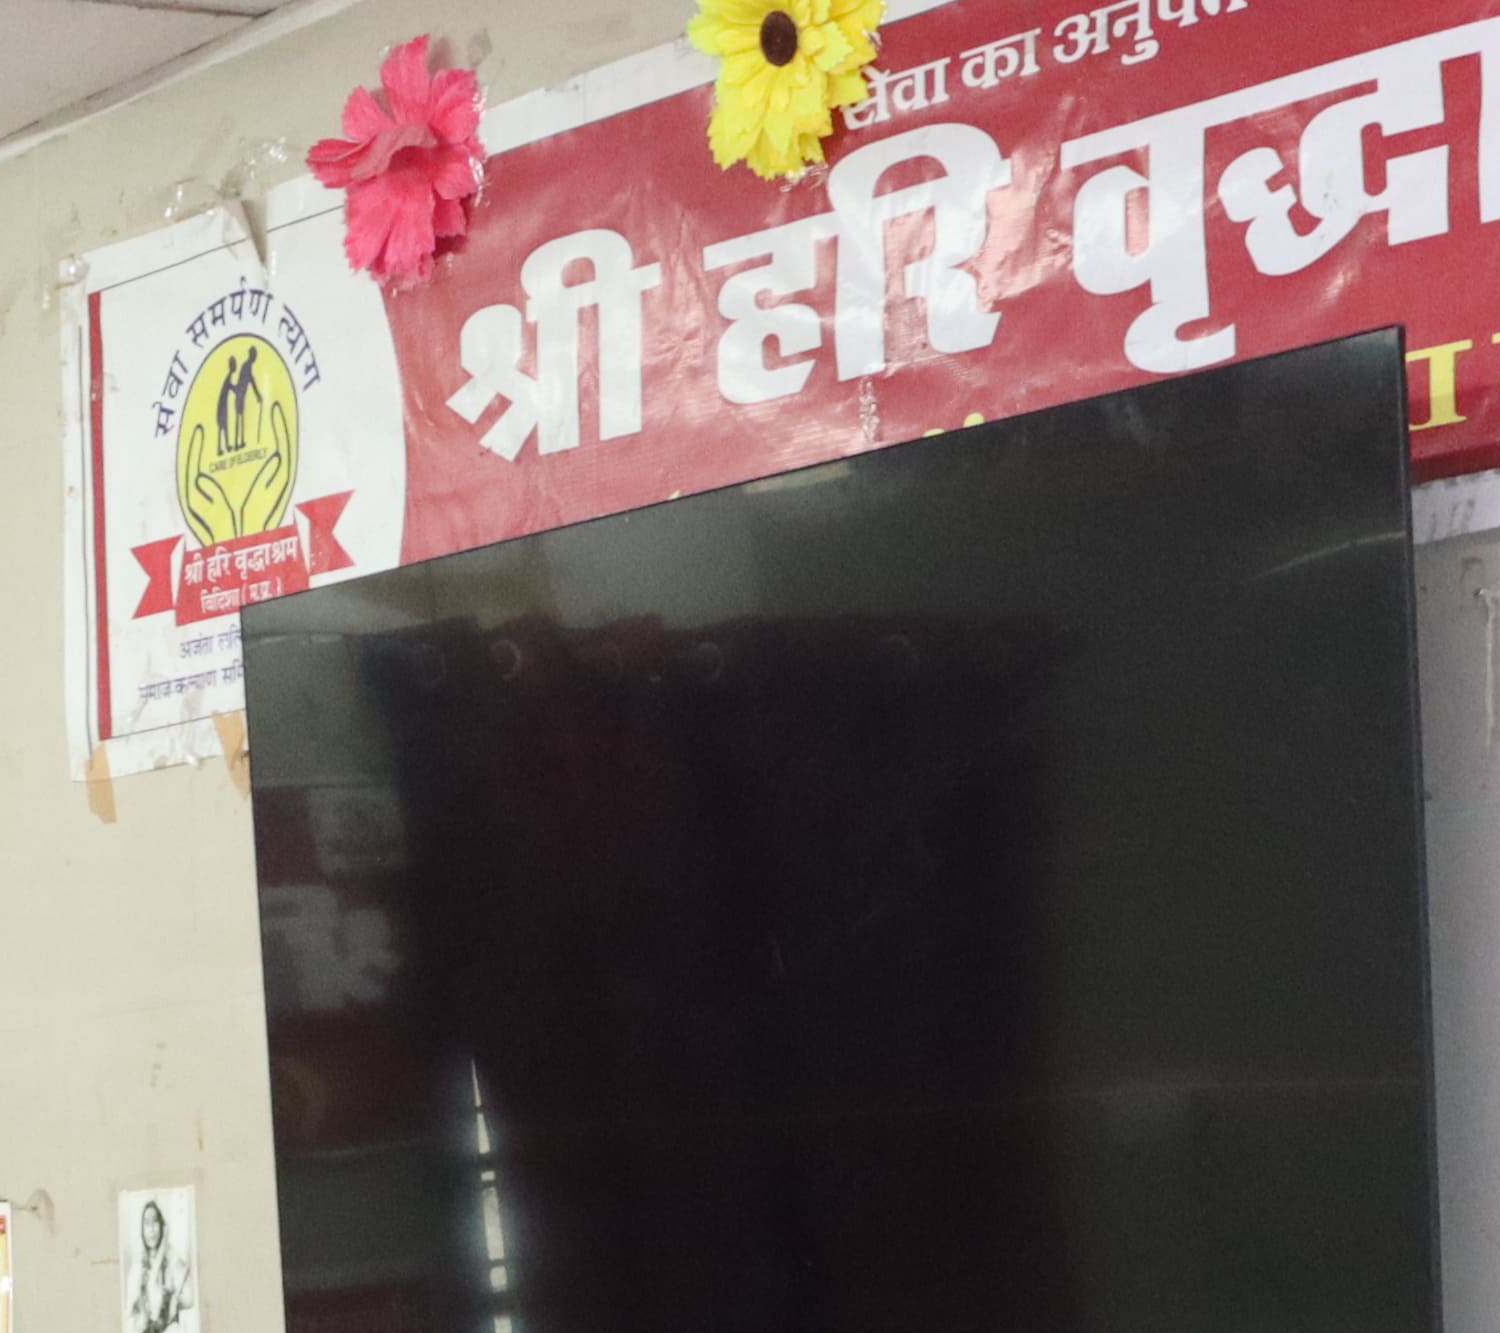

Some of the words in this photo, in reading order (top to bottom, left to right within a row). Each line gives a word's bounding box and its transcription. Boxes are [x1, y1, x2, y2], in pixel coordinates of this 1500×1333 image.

[841, 57, 950, 132] सेवा
[960, 28, 1042, 89] का
[185, 275, 274, 348] समर्पण
[278, 303, 321, 392] त्याग
[446, 228, 660, 462] श्री
[704, 121, 1011, 404] हरि
